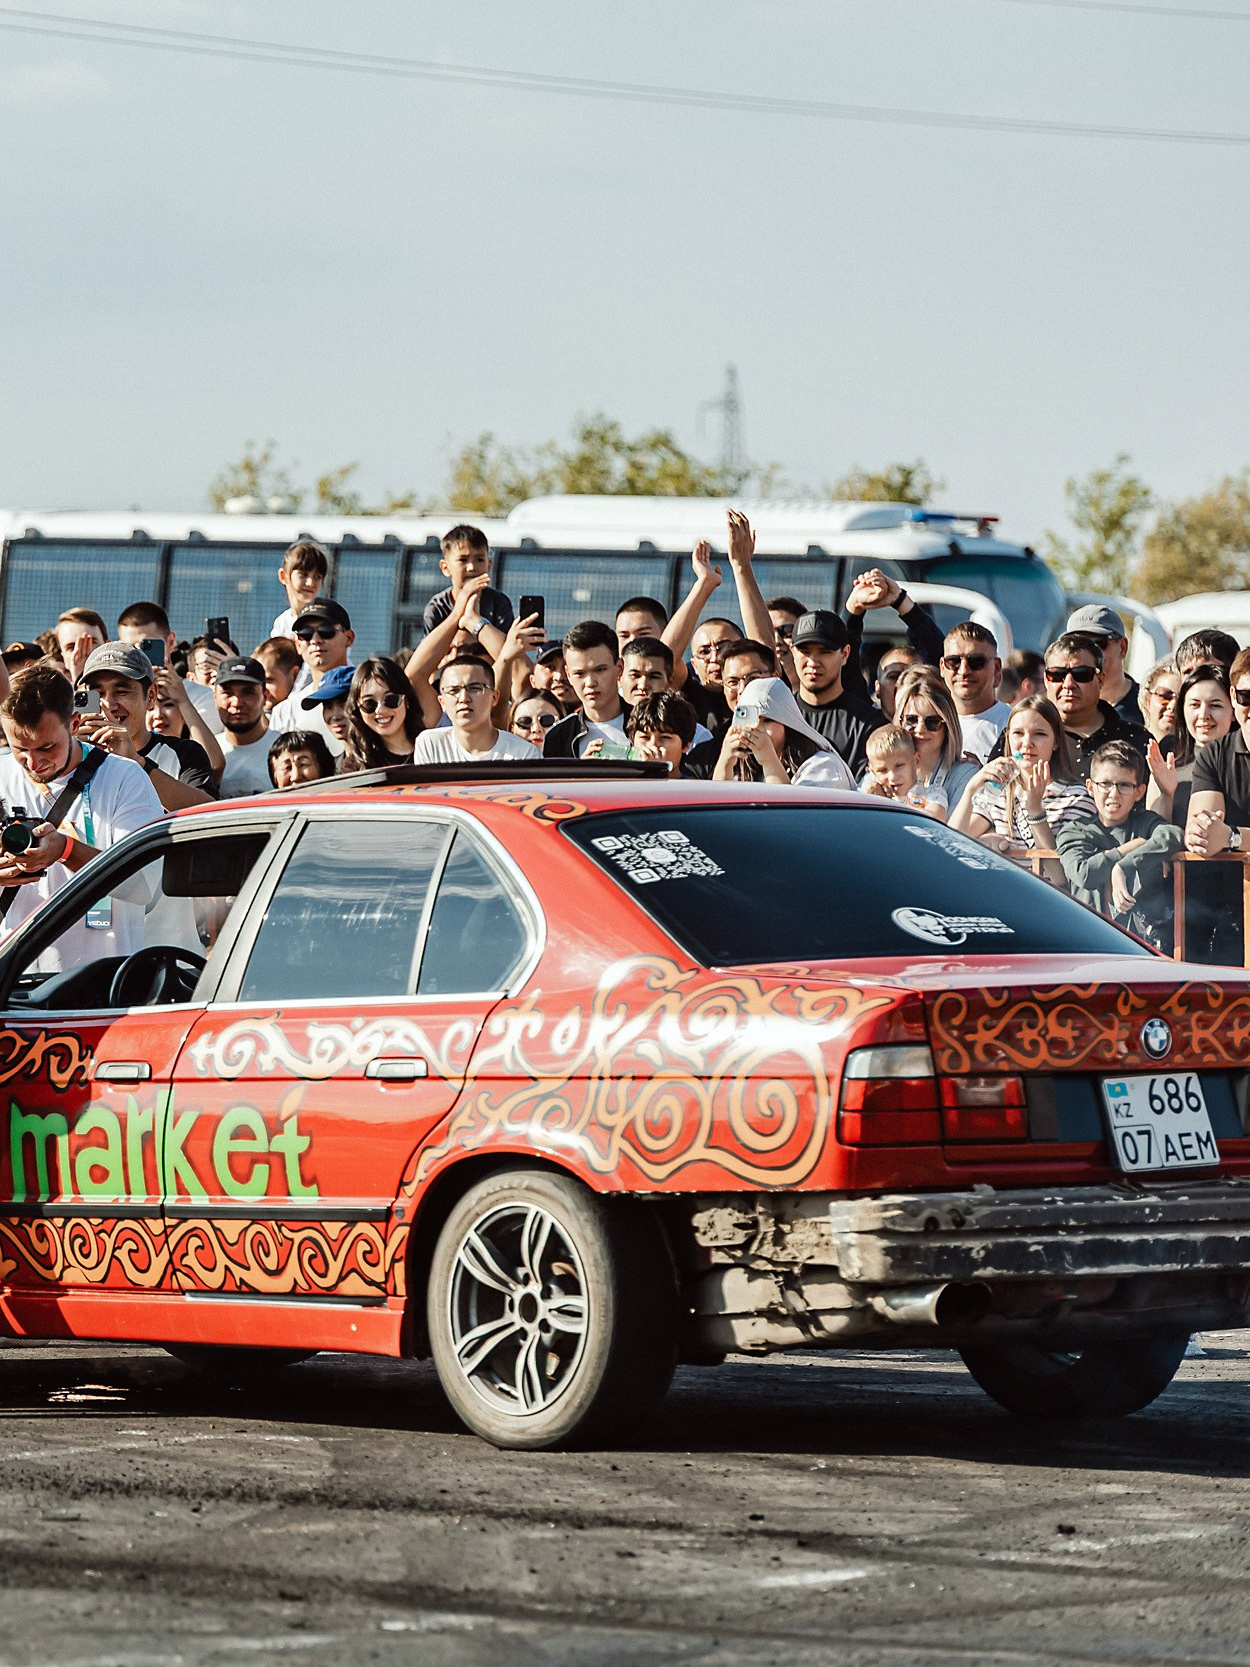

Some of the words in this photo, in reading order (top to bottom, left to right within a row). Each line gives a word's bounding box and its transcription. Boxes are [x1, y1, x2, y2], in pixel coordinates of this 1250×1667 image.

[1113, 1102, 1134, 1118] KZ
[1148, 1076, 1202, 1115] 686
[10, 1086, 320, 1204] market
[1121, 1129, 1152, 1165] 07
[1164, 1130, 1218, 1162] AEM
